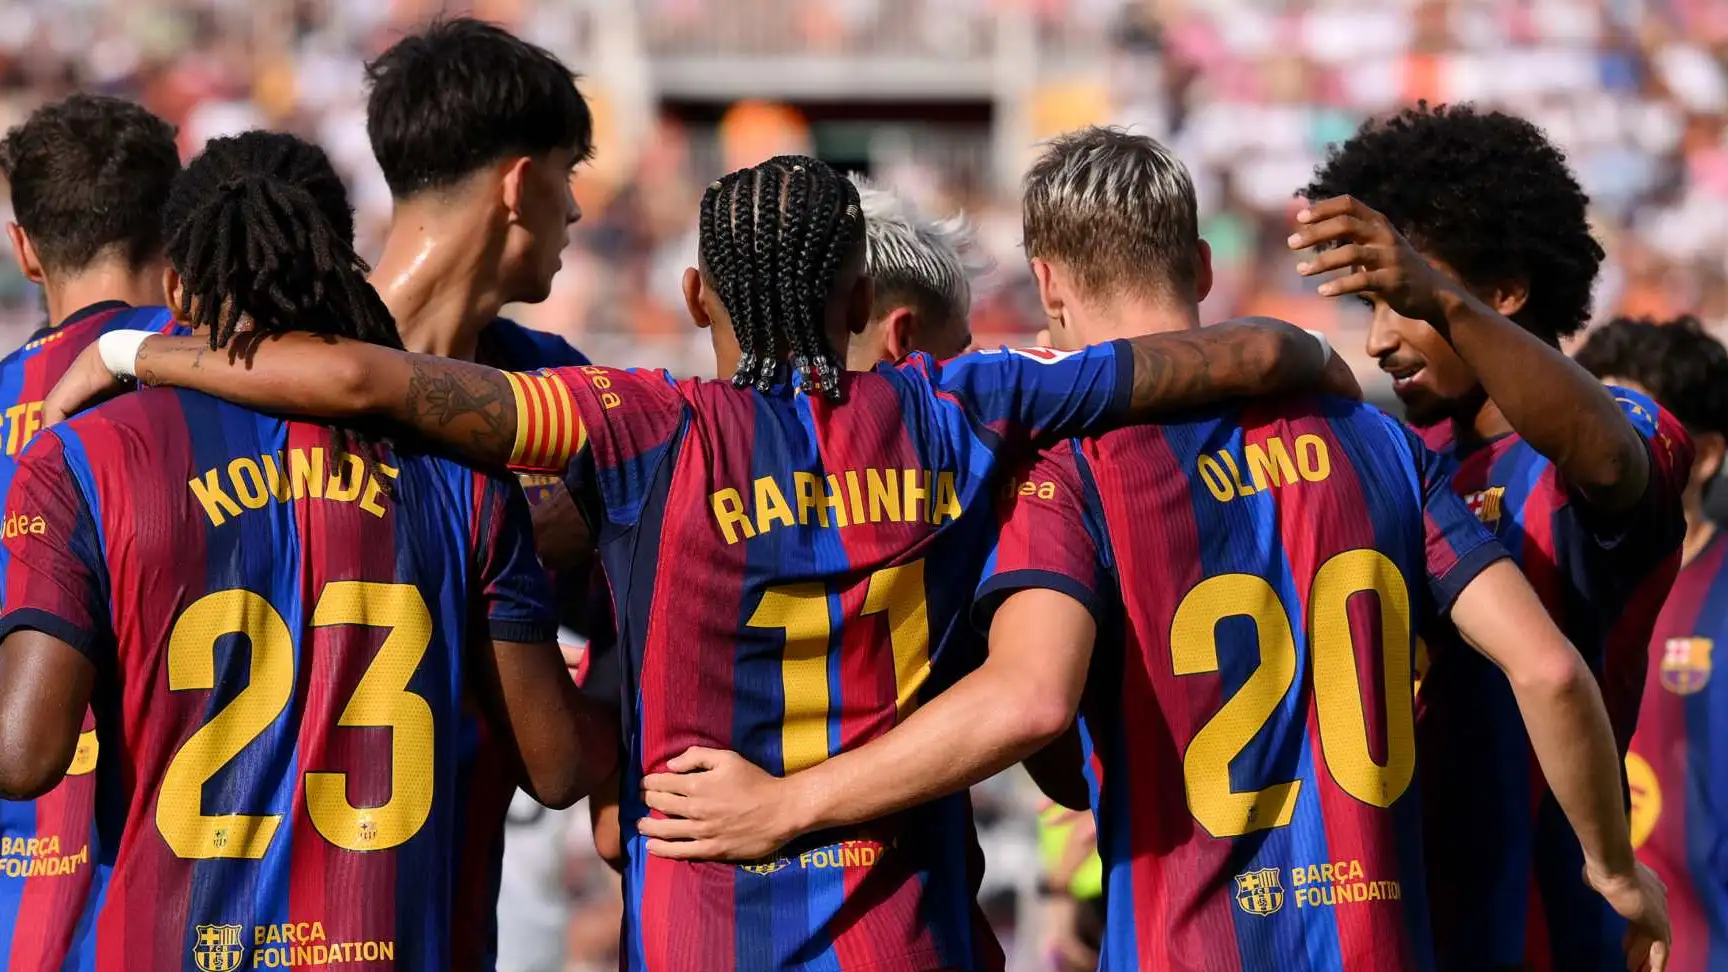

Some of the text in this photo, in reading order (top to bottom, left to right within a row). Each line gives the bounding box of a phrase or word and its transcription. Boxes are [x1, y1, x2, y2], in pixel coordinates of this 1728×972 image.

[0, 401, 44, 455] TE
[1197, 434, 1331, 502] OLMO
[709, 468, 962, 545] RAPHINHA
[746, 557, 931, 777] 11
[1170, 548, 1415, 837] 20
[156, 581, 434, 859] 23
[2, 836, 60, 858] BARÇA
[1291, 860, 1364, 886] BARÇA
[253, 941, 394, 969] FOUNDATION
[254, 921, 326, 945] BARÇA
